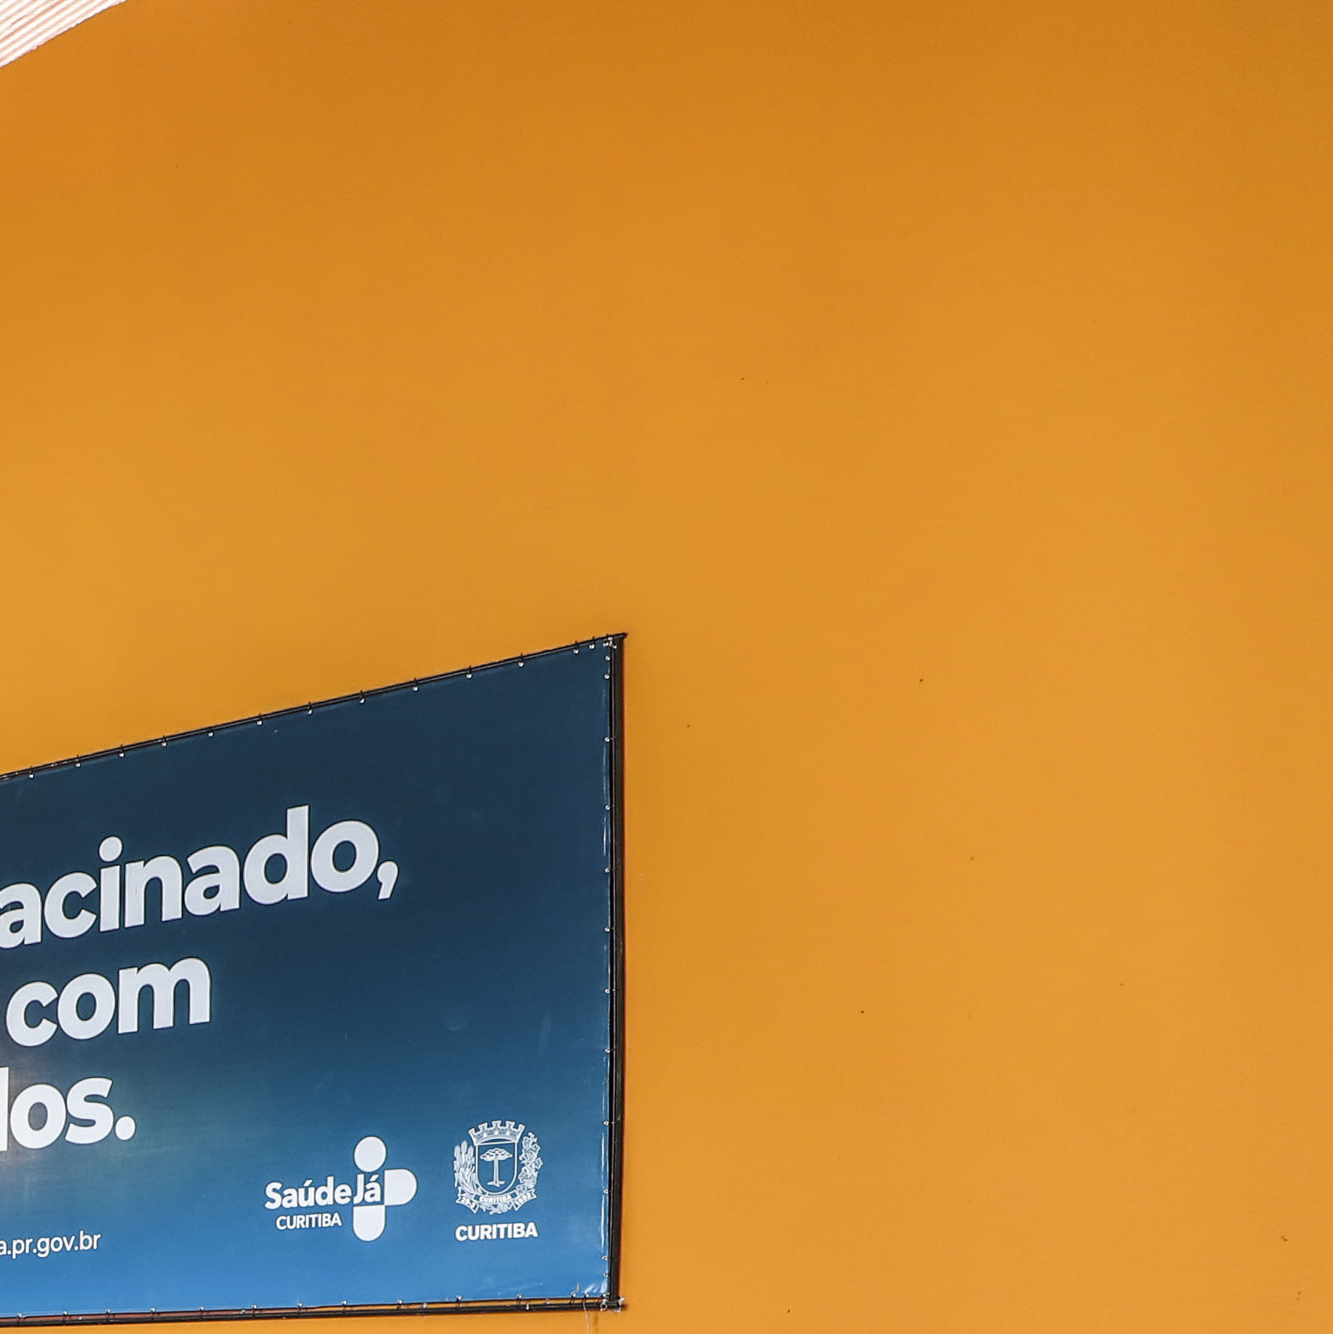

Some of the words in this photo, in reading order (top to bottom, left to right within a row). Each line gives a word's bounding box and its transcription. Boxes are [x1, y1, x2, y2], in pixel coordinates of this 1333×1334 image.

[6, 958, 211, 1047] com
[275, 1212, 342, 1230] CURITIBA
[455, 1222, 539, 1242] CURITIBA
